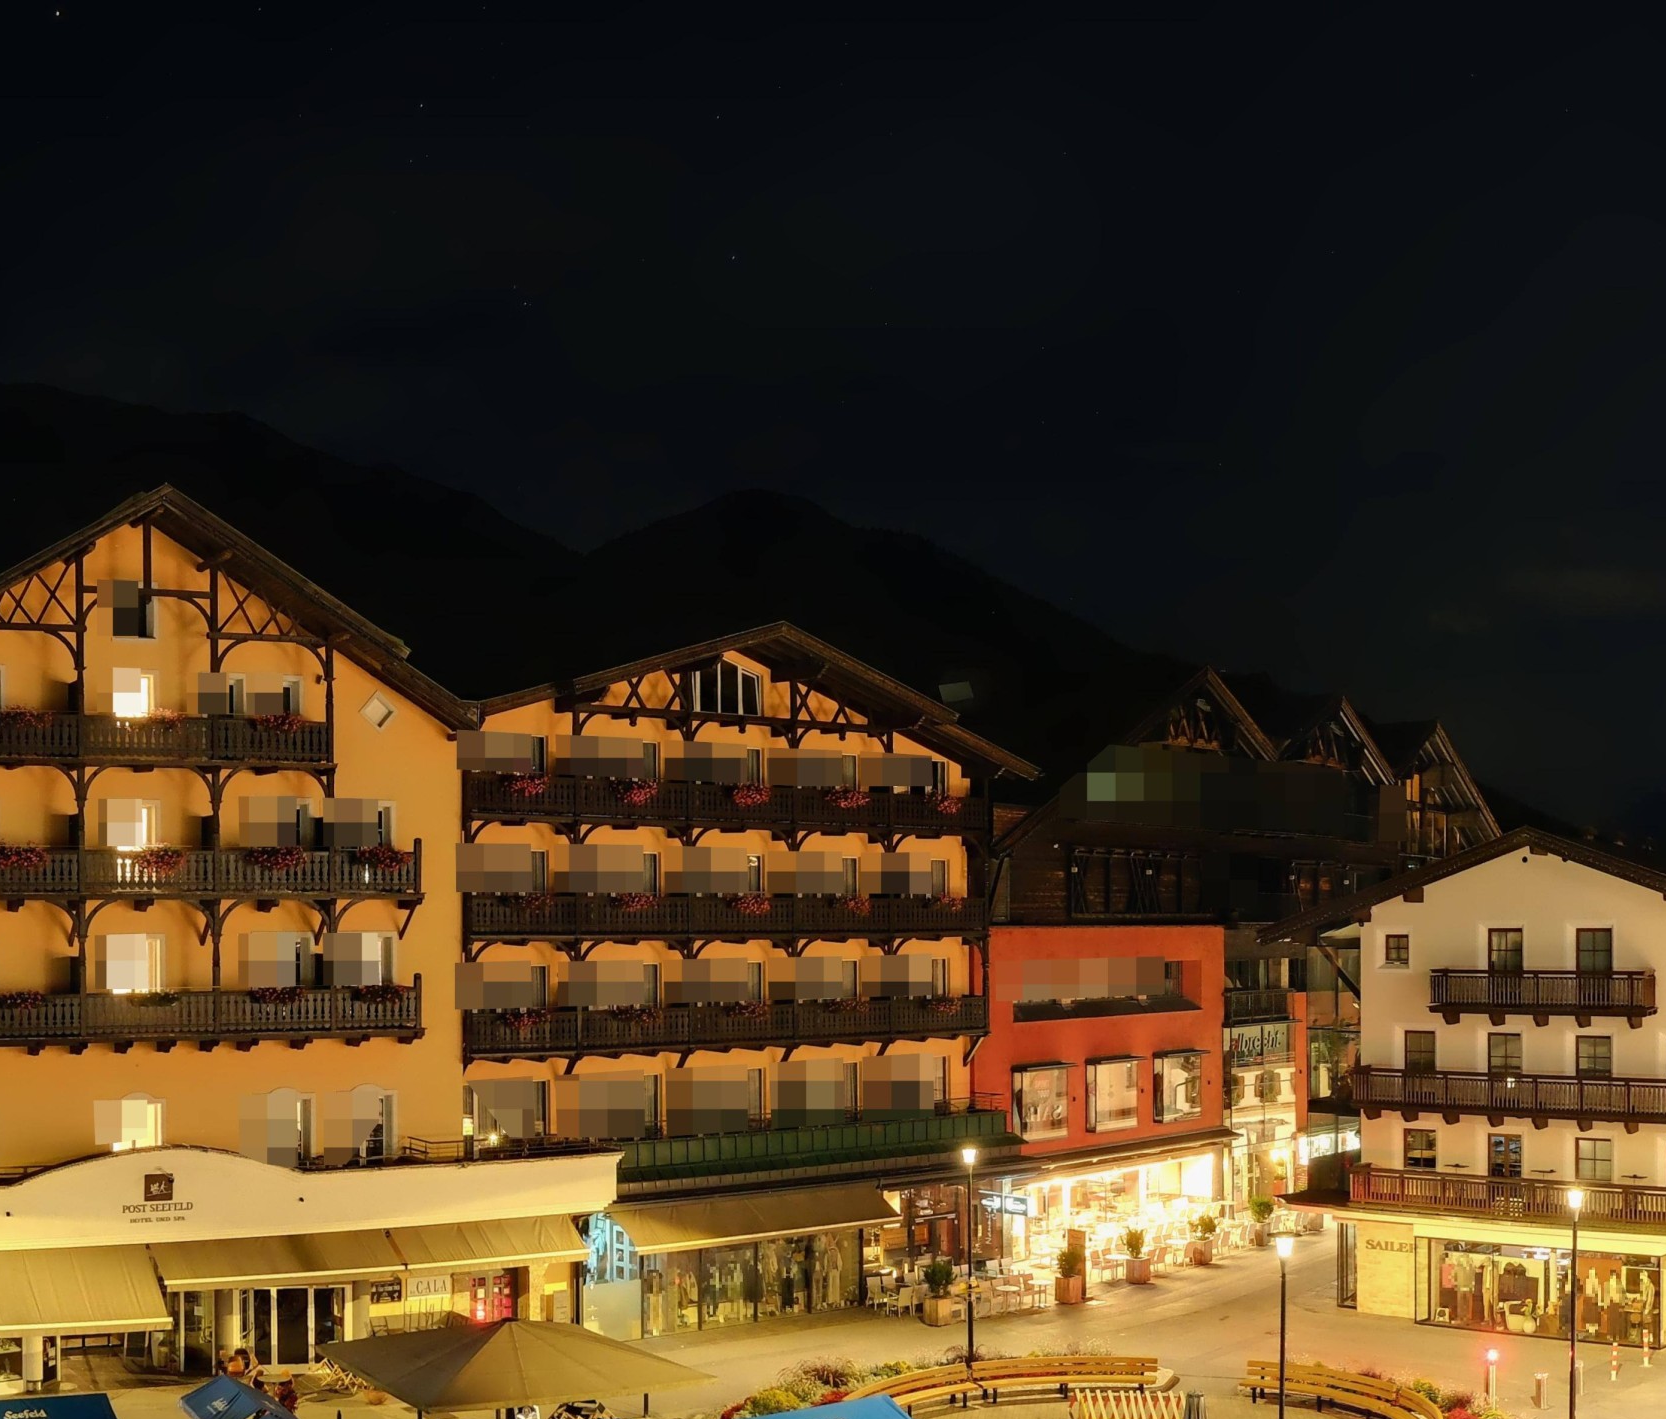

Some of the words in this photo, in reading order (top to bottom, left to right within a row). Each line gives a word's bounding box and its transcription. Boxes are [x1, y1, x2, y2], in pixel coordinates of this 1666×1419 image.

[122, 1204, 146, 1214] POST
[149, 1202, 194, 1212] SEEFELD
[416, 1279, 446, 1293] CALA
